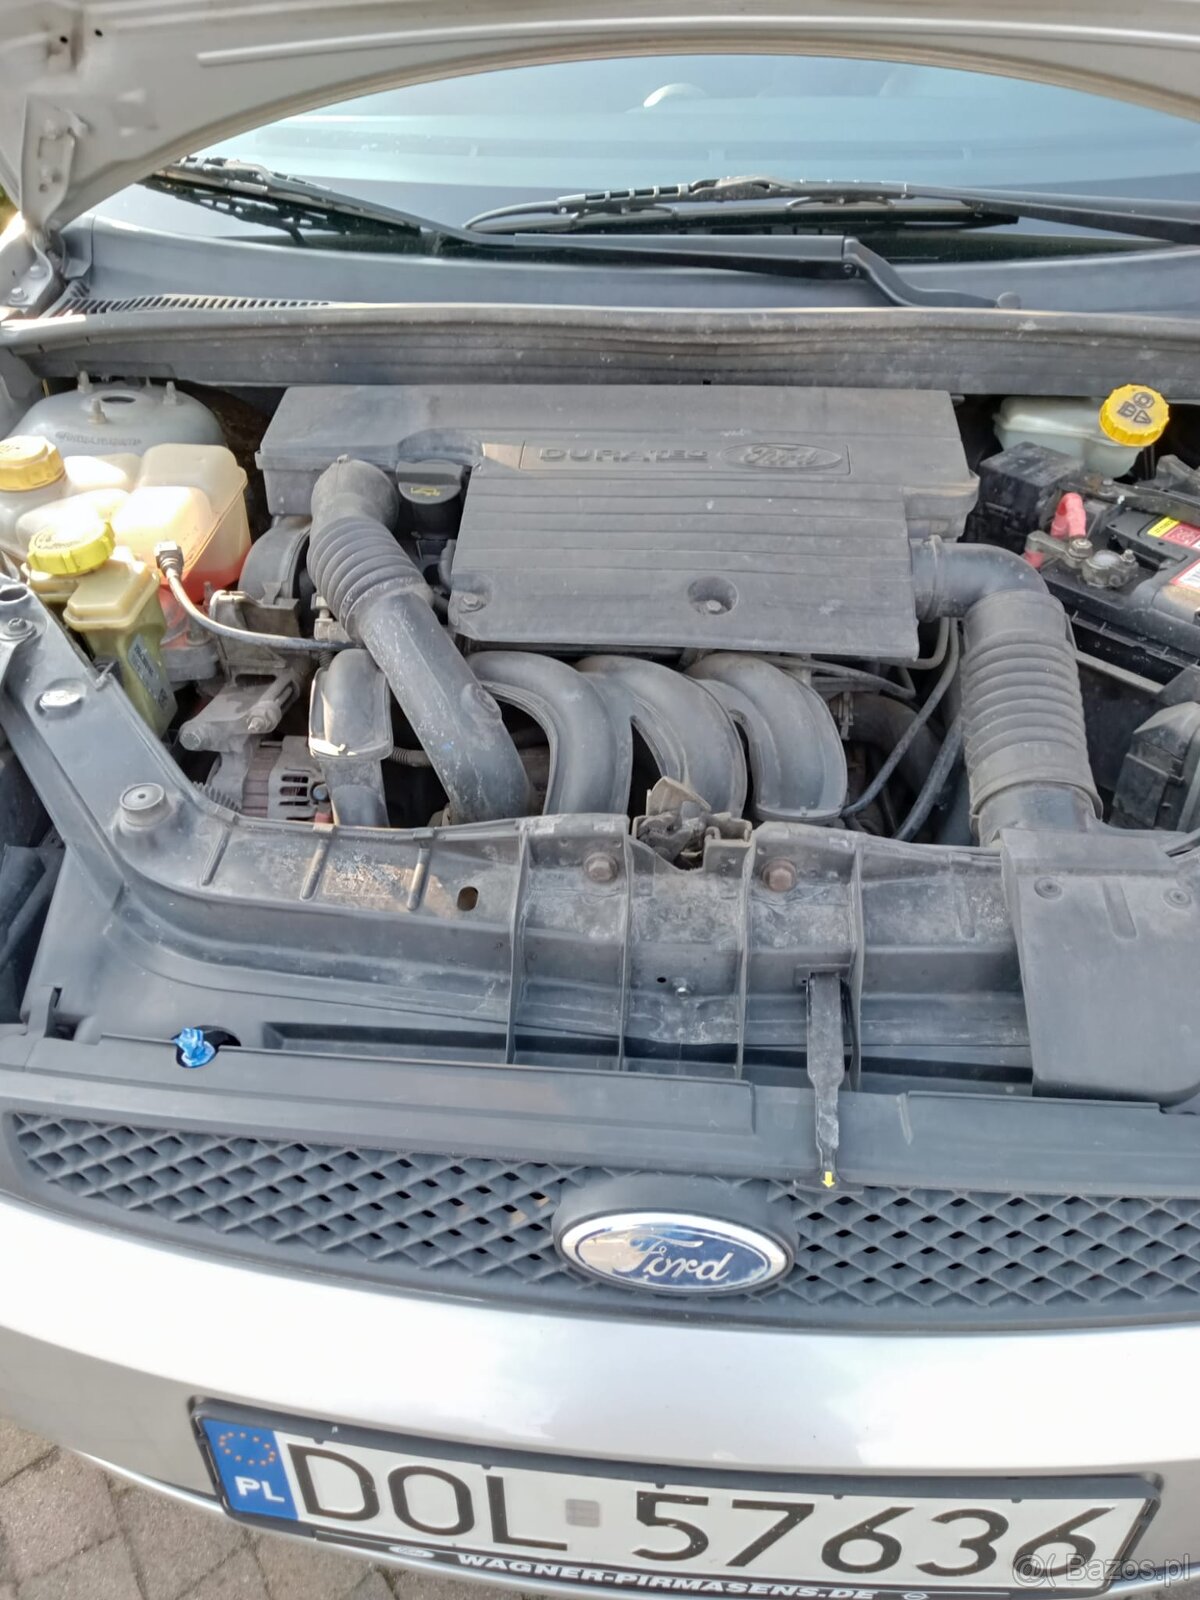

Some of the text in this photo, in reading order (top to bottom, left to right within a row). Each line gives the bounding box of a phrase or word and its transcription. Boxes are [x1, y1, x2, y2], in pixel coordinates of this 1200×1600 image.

[612, 1232, 735, 1282] Ford
[233, 1475, 286, 1503] PL
[287, 1443, 1116, 1578] DOL 57636
[456, 1553, 880, 1600] WAGNER-PIRMASENS.DE
